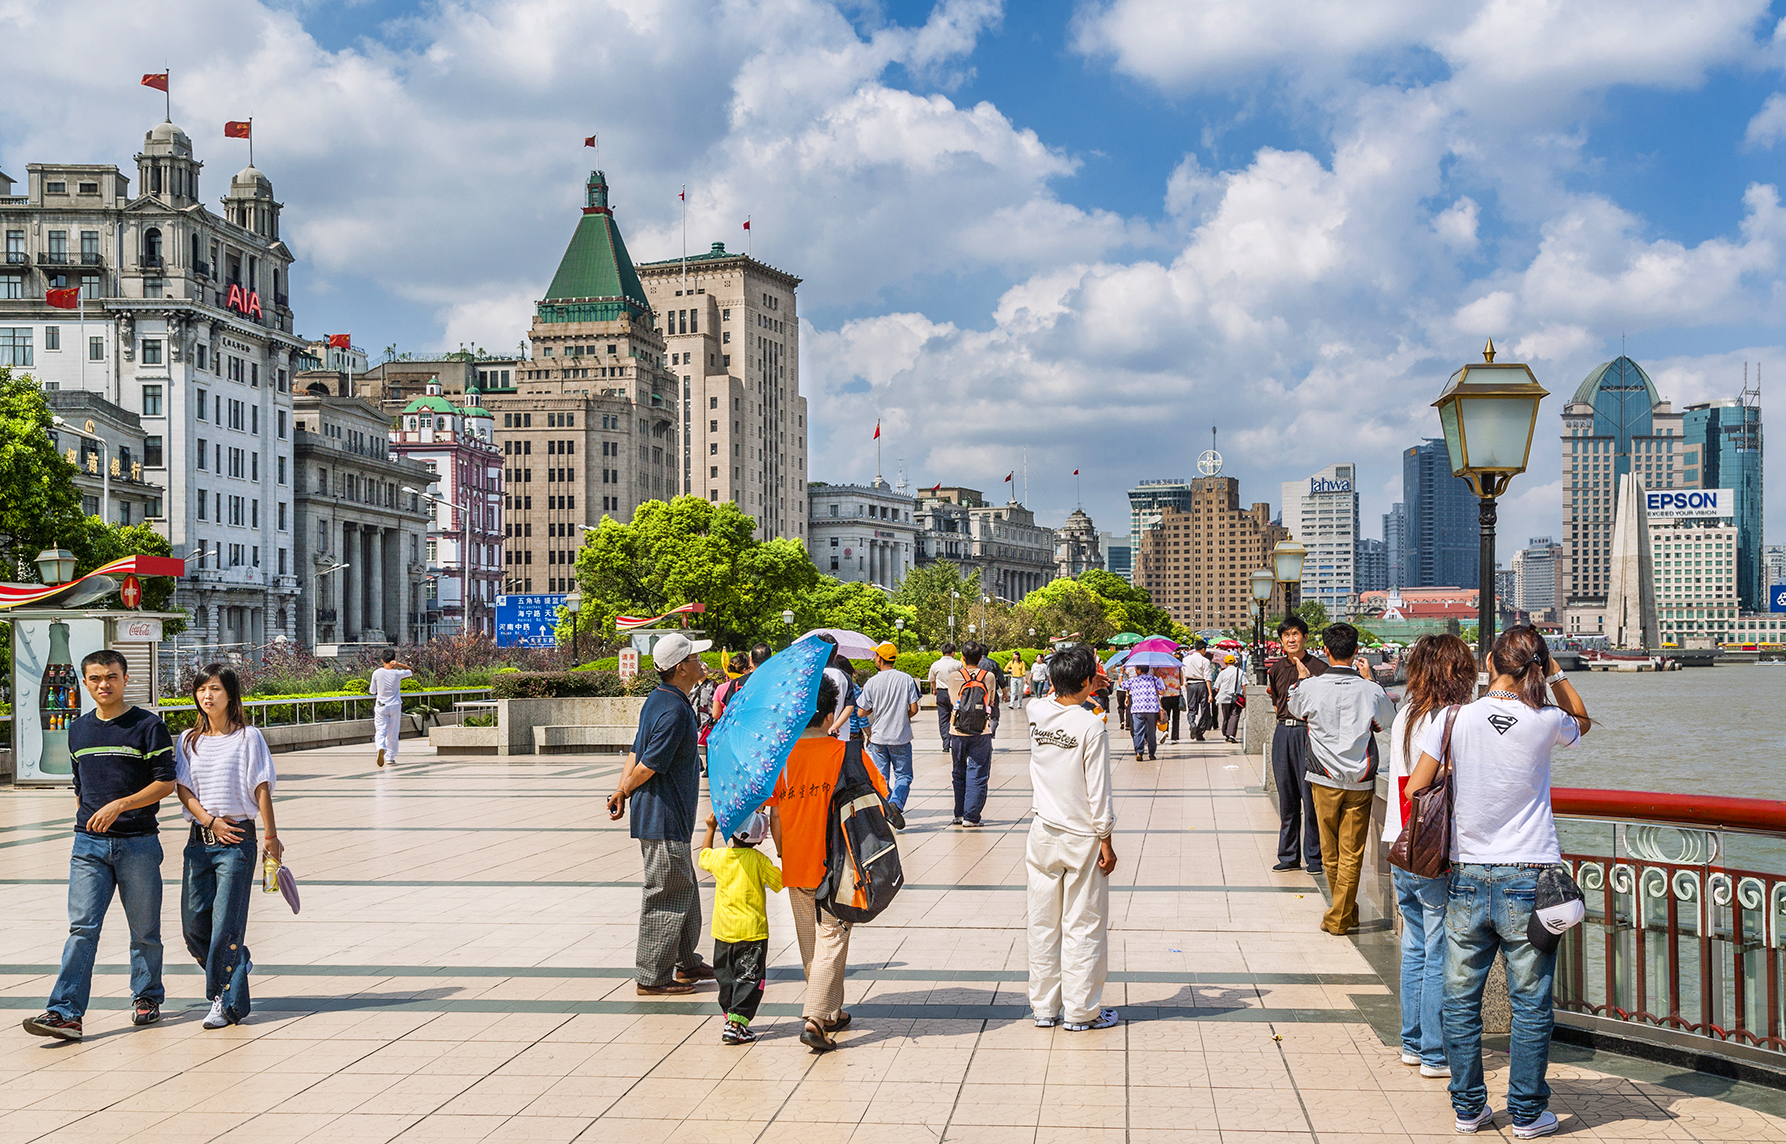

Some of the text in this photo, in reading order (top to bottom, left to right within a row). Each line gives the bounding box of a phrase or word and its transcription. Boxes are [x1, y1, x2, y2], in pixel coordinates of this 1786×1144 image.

[226, 284, 262, 319] AIA
[65, 447, 141, 480] 招商银行
[1309, 477, 1351, 497] Jahwa
[1647, 492, 1717, 509] EPSON
[518, 597, 541, 605] 五角场
[779, 781, 836, 802] 快乐星打印
